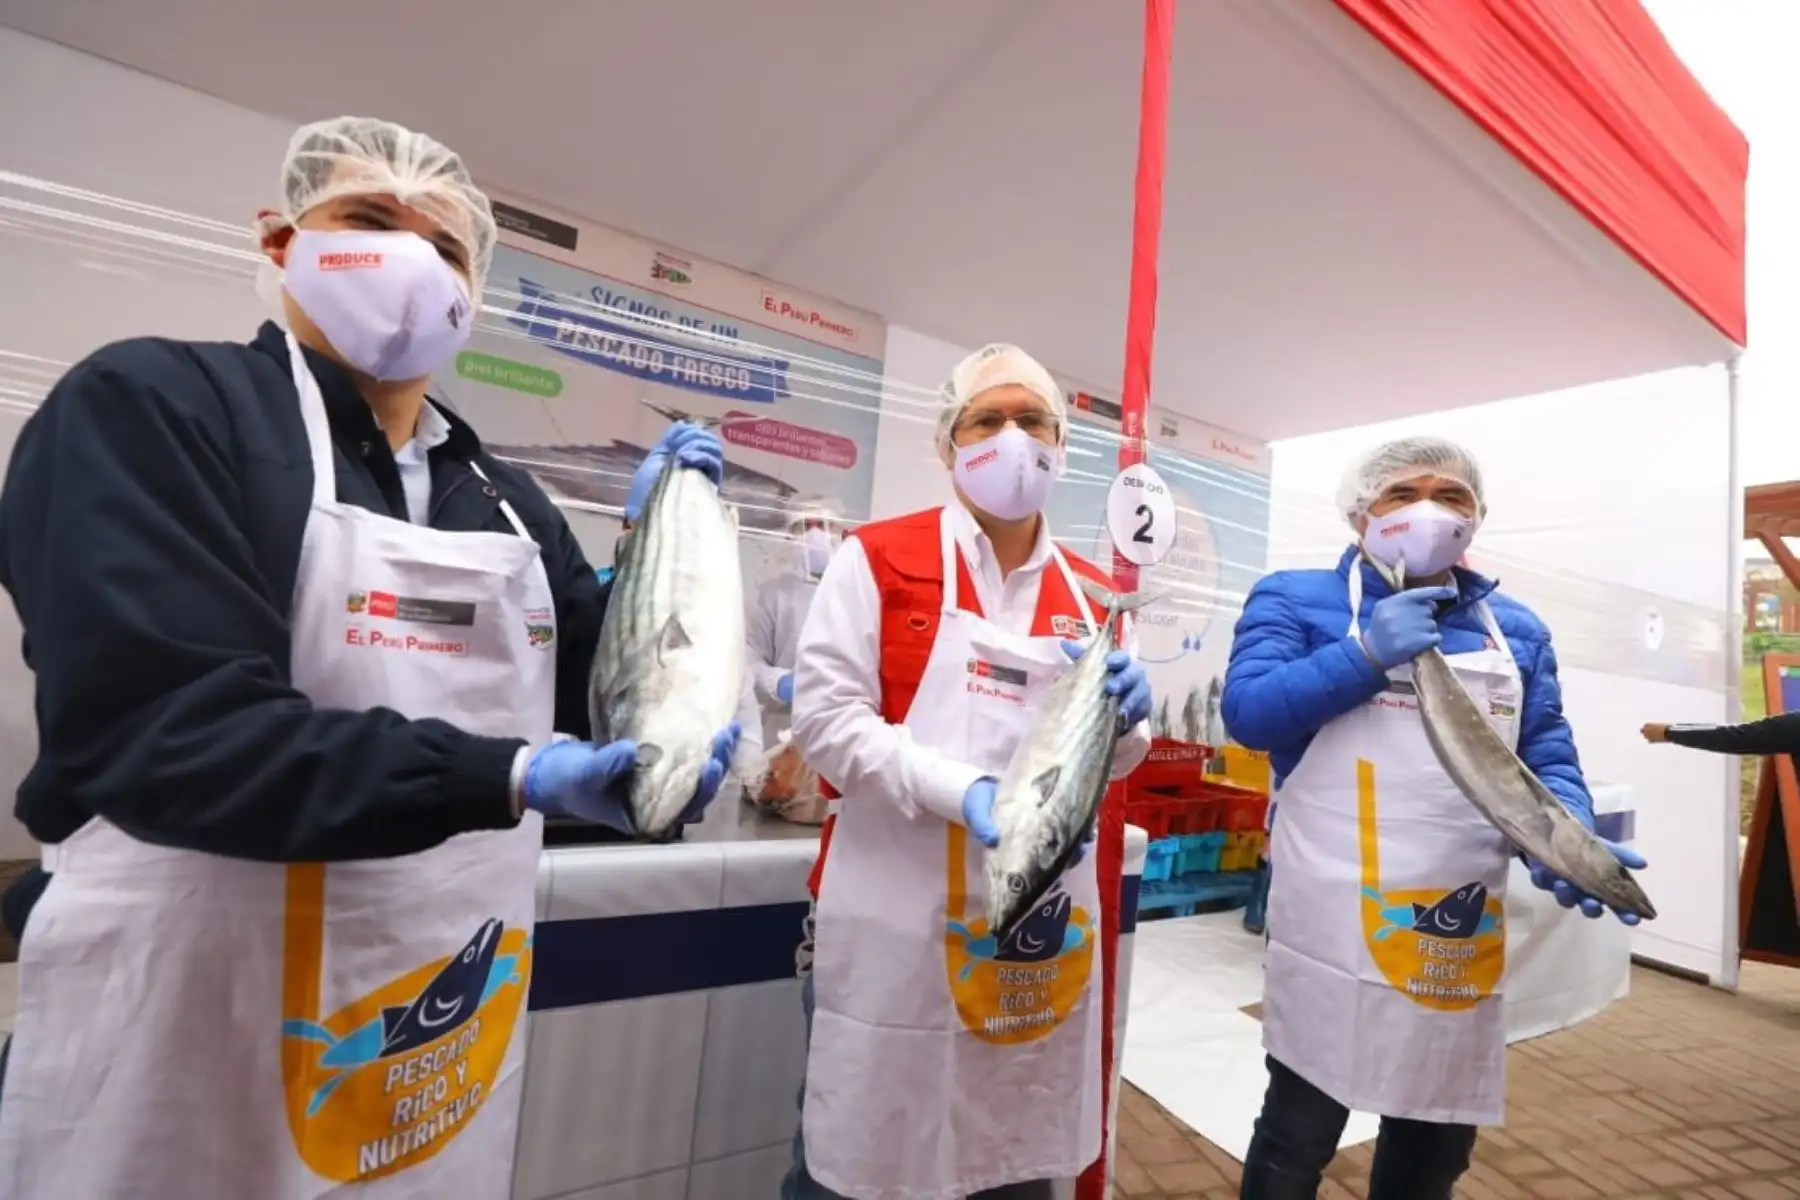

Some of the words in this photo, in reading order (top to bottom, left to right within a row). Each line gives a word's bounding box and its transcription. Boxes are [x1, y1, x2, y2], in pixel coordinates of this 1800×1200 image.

[319, 252, 382, 267] PRODUCE
[557, 320, 663, 374] PESCADO
[672, 357, 751, 391] FRESCO
[1132, 503, 1155, 545] 2
[1418, 938, 1476, 959] PESCADO
[998, 964, 1059, 986] PESCADO
[384, 1020, 480, 1093] PESCADO
[456, 1060, 468, 1085] Y
